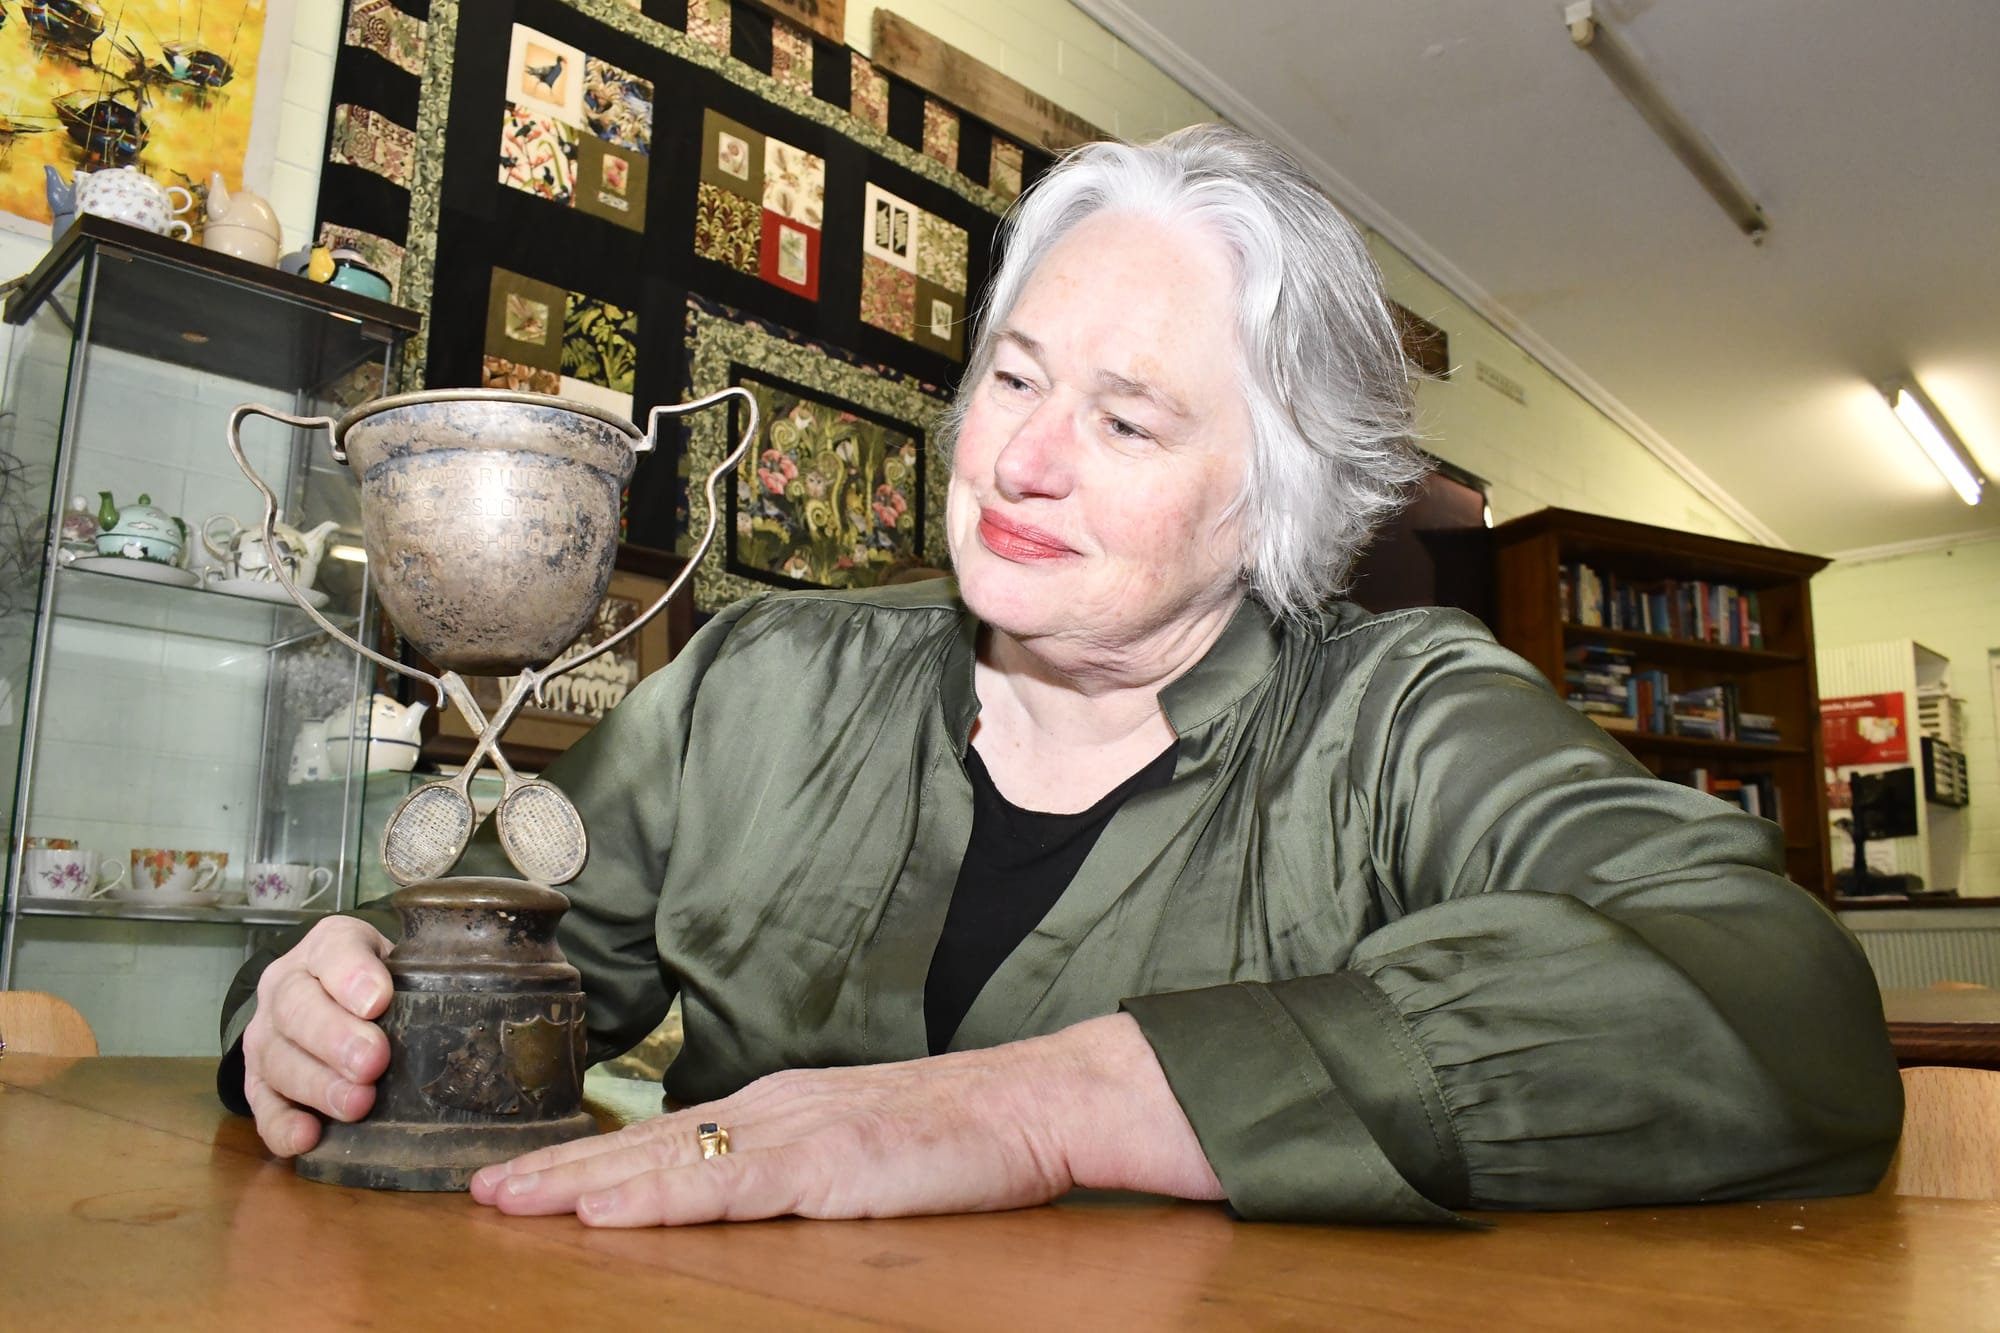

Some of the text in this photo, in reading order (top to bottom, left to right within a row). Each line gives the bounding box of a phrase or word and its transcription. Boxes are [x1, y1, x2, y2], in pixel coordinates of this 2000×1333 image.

[387, 465, 555, 497] ONKAPARINGA
[378, 496, 576, 526] NNIS ASSOCIATION
[389, 528, 563, 555] MIERSHIP CP
